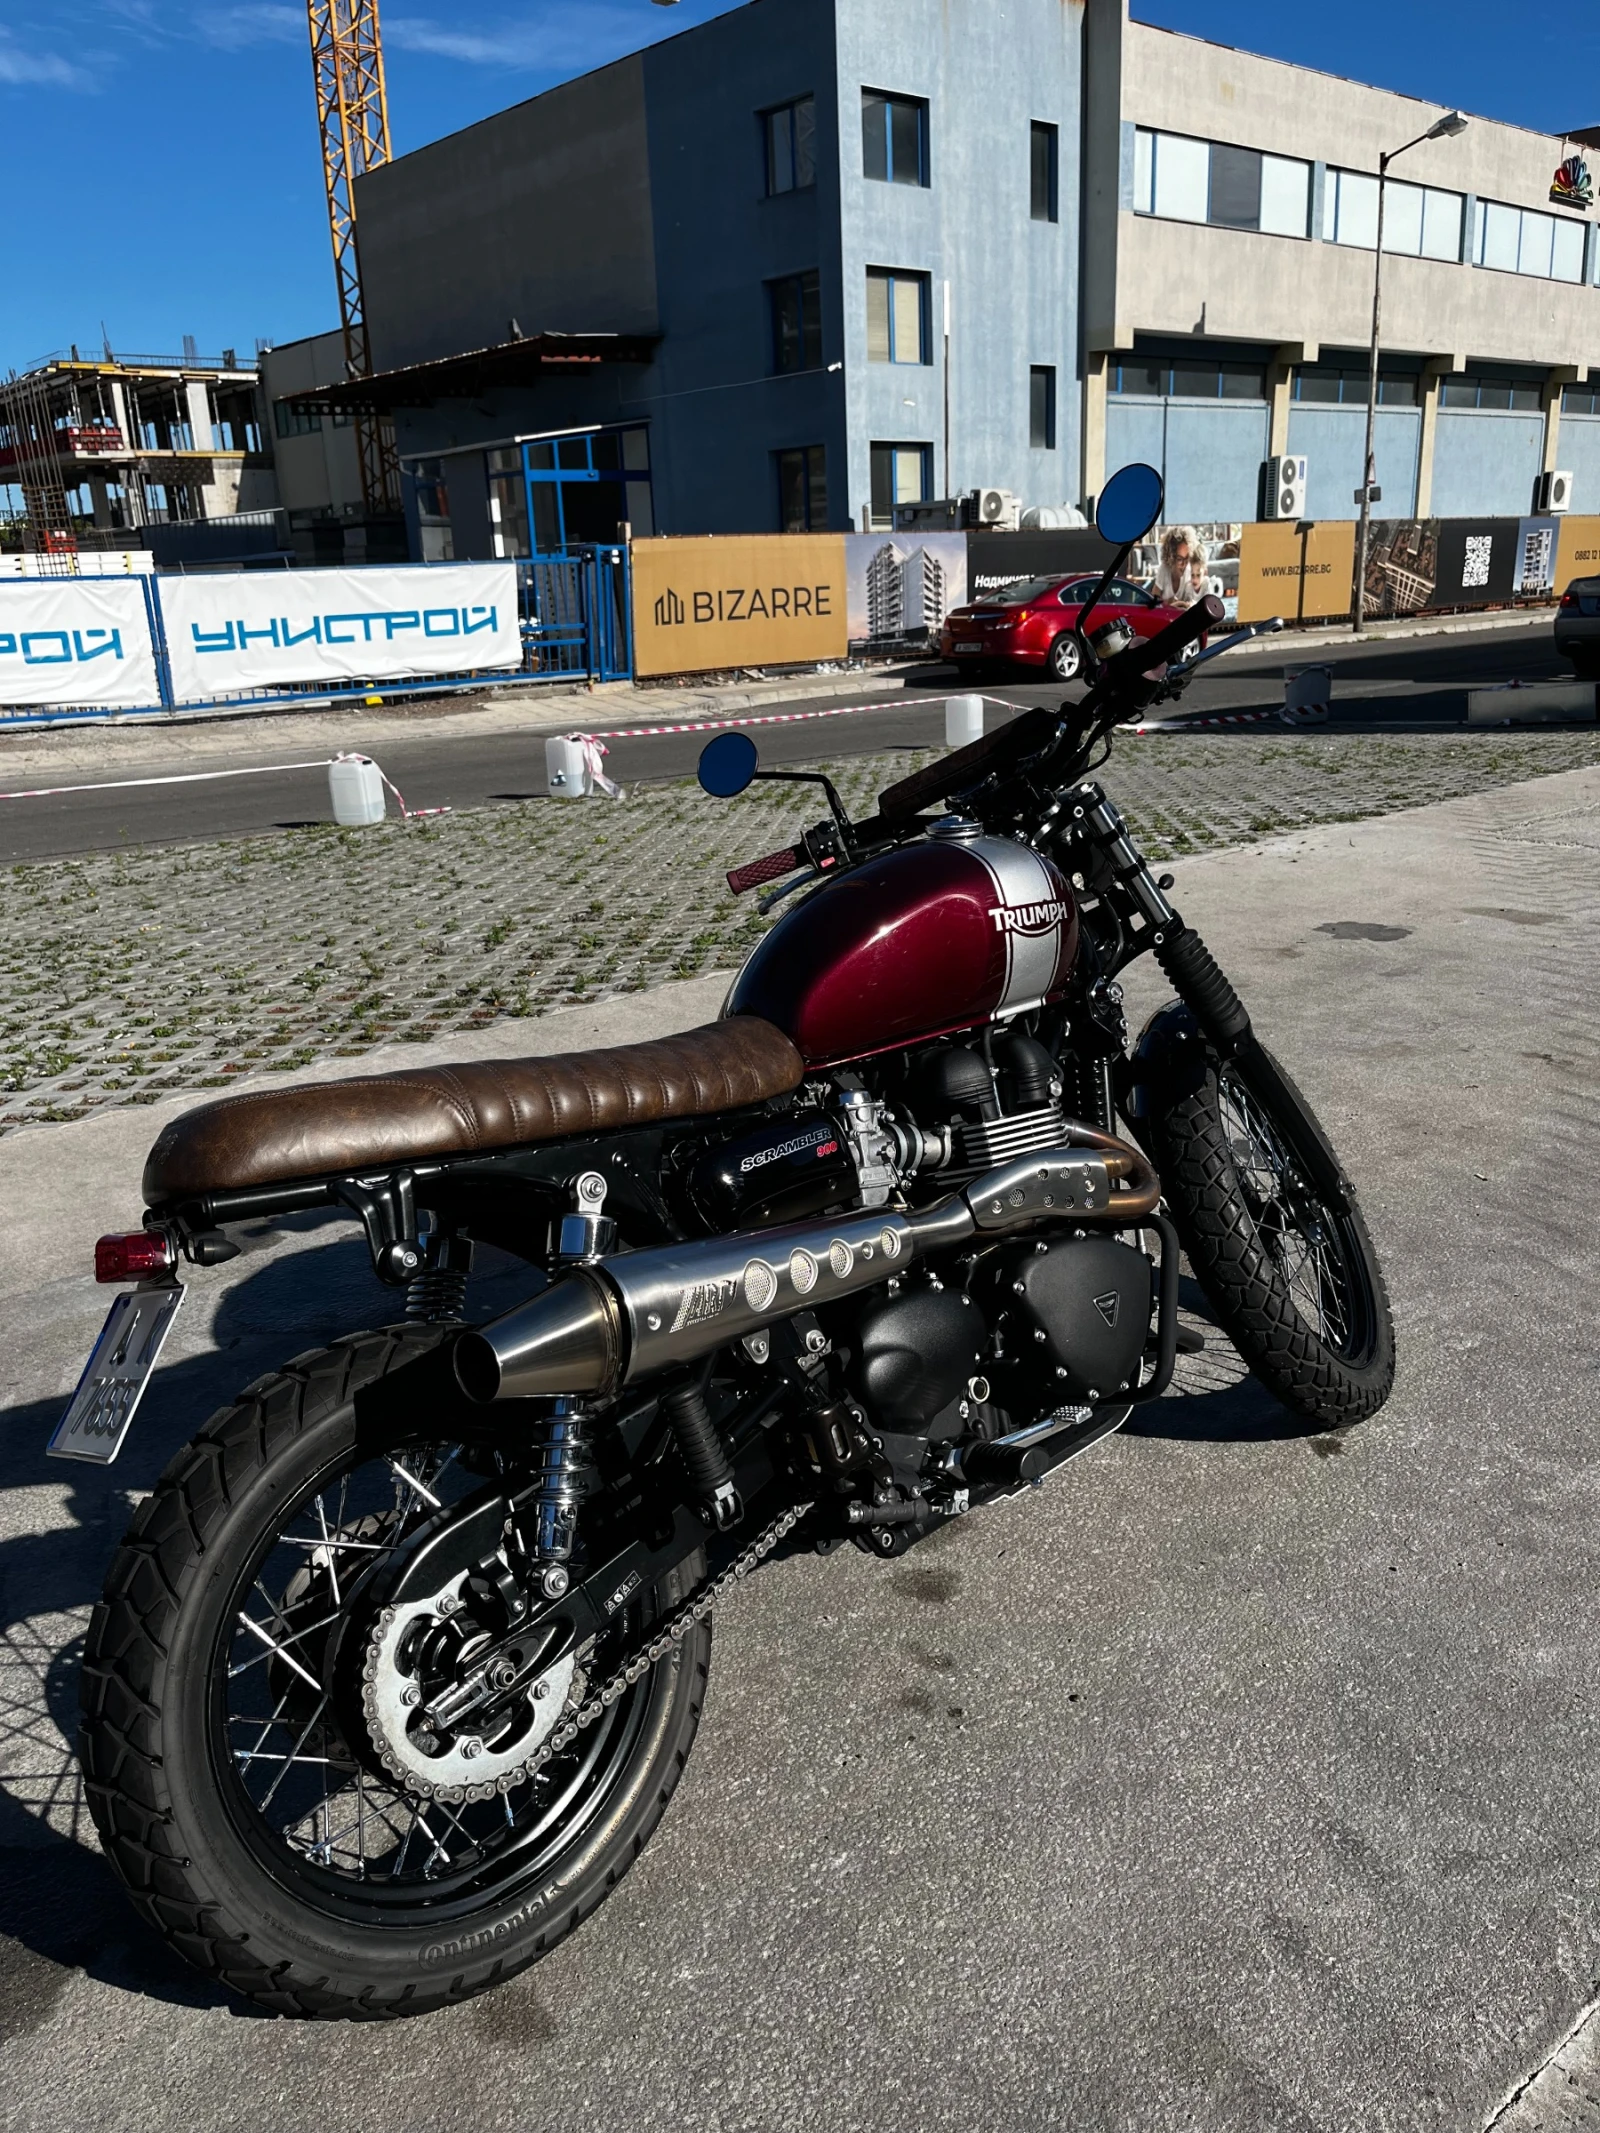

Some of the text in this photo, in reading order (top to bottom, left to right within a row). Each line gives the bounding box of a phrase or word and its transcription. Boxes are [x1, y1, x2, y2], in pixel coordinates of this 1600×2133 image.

[693, 586, 831, 623] BIZARRE
[191, 606, 498, 653] УНИСТРОЙ
[988, 902, 1068, 934] TRIUMPH
[741, 1128, 832, 1172] SCRAMBLER
[817, 1141, 838, 1157] 900
[70, 1377, 142, 1437] 7655
[418, 1889, 551, 1971] Continental
